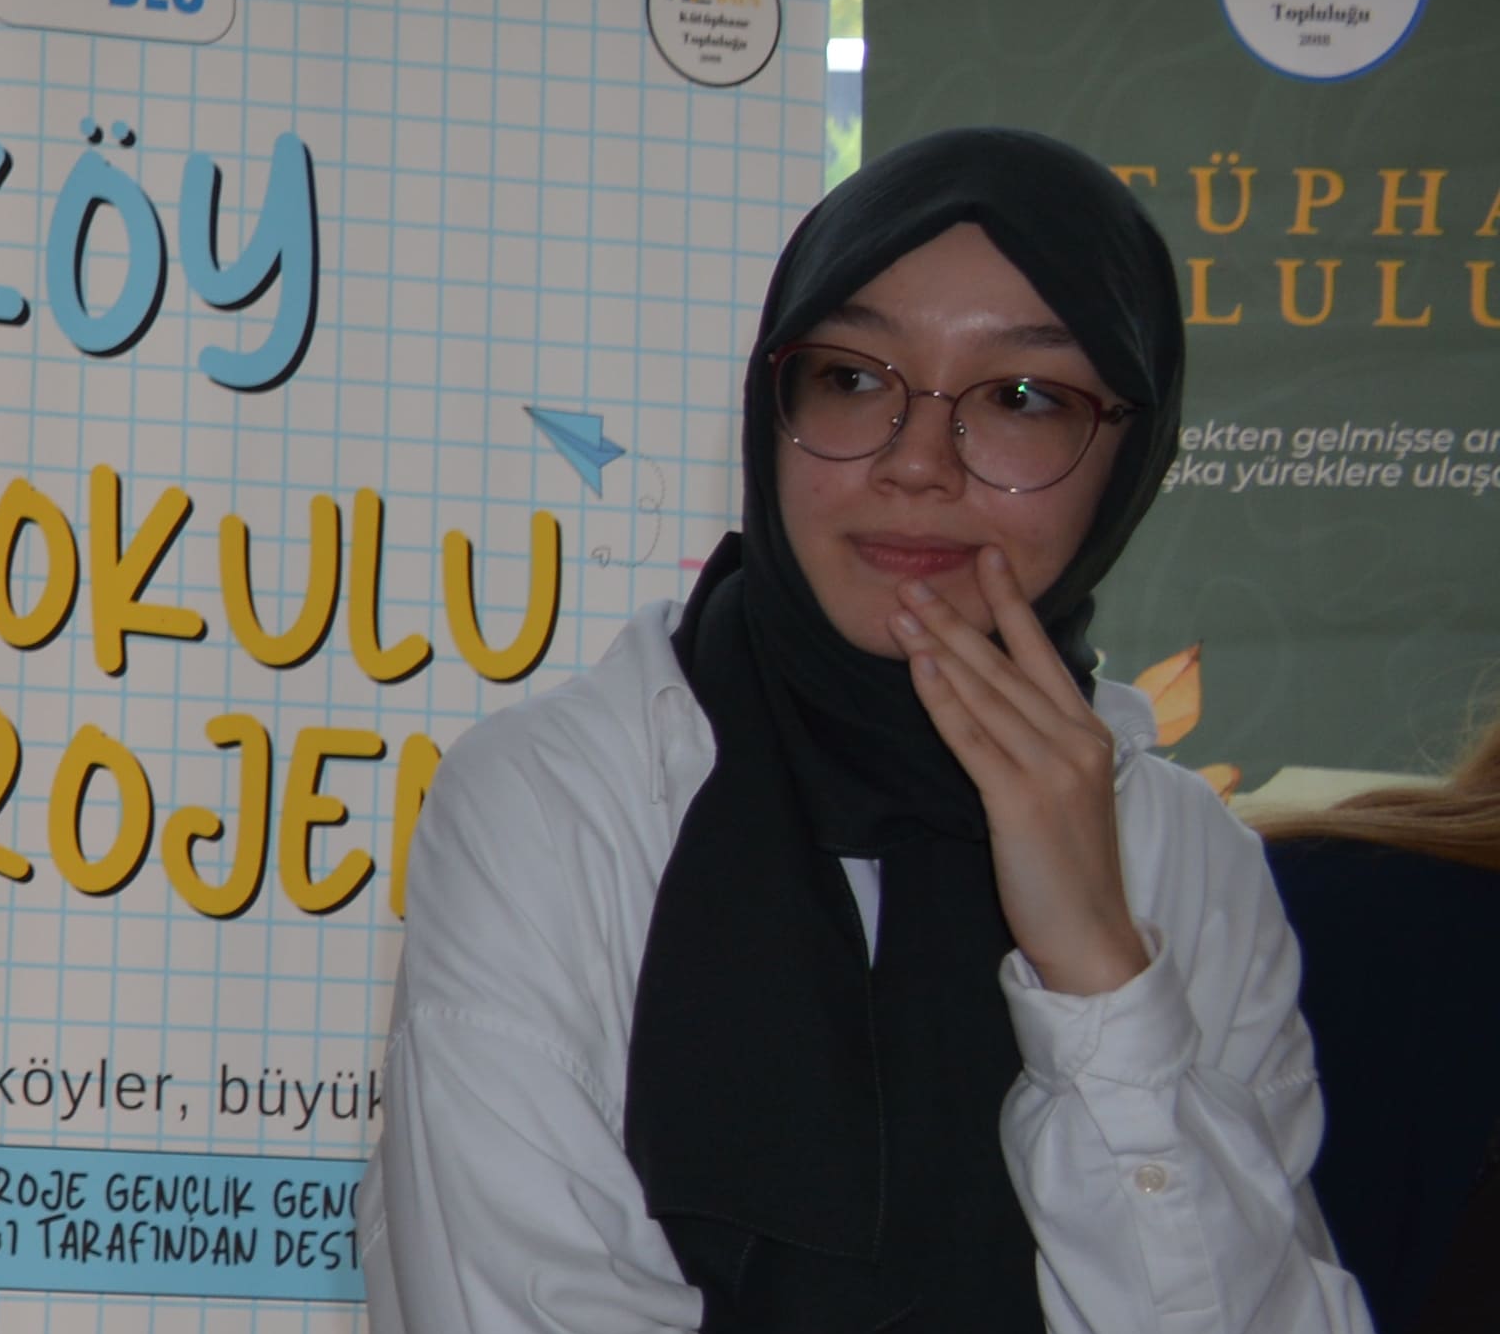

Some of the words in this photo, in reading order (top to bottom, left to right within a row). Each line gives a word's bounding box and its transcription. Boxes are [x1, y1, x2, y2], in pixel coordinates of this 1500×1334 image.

[1272, 2, 1371, 27] Topluluğu
[1180, 419, 1283, 452] ekten
[1291, 420, 1455, 460] gelmişse
[1230, 455, 1404, 493] yüreklere
[37, 1212, 259, 1265] TARAFINDAN
